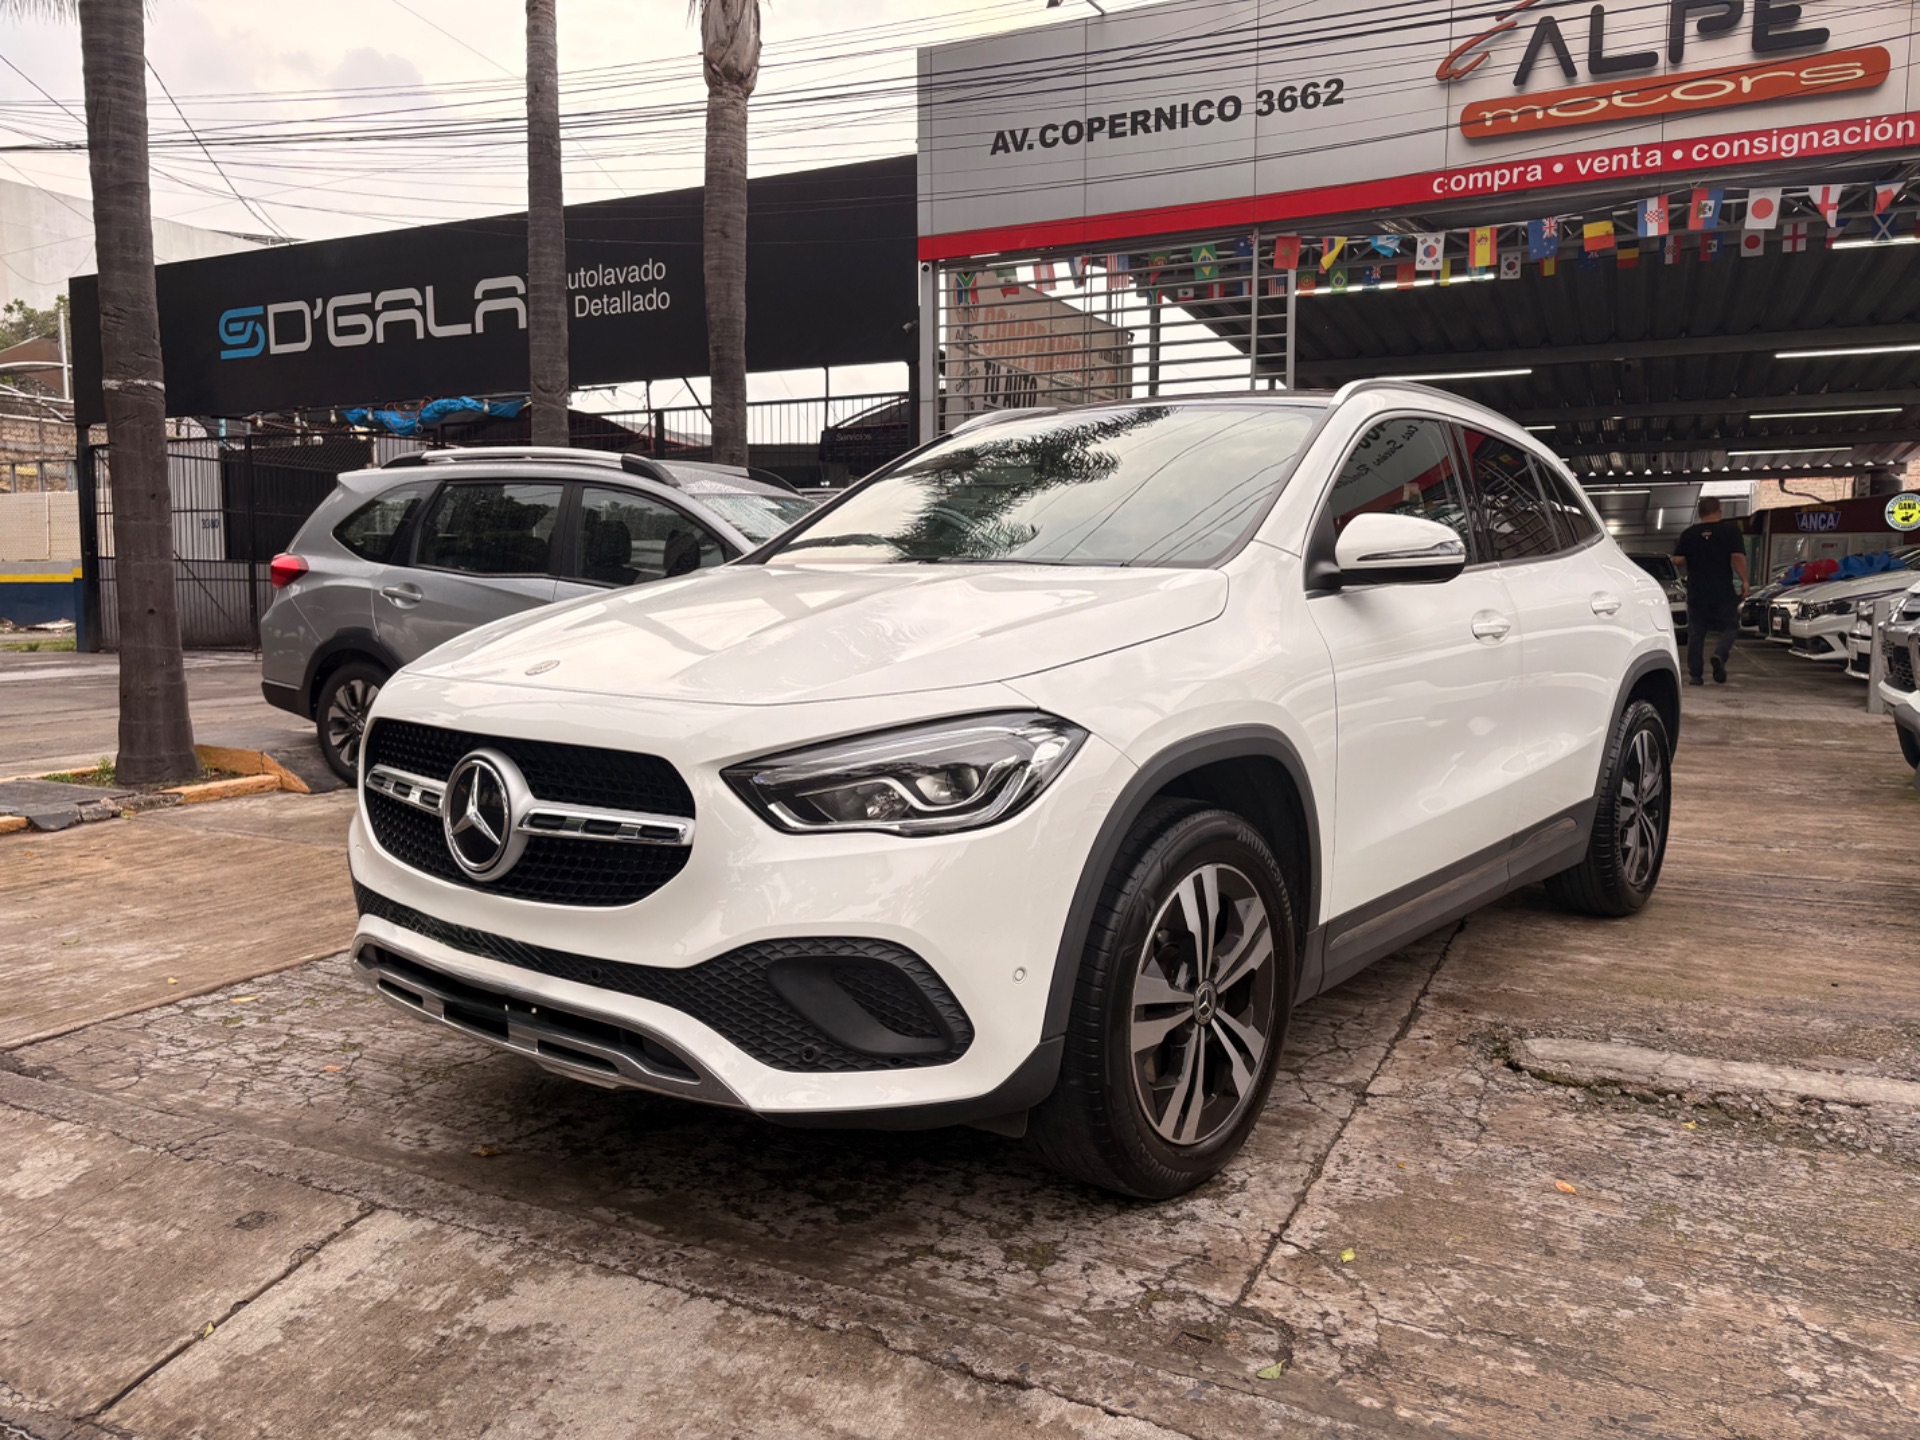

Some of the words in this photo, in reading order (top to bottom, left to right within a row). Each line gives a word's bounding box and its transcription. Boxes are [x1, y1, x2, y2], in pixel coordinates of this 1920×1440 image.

[1255, 78, 1345, 117] 3662
[1478, 60, 1866, 126] motors
[1432, 161, 1543, 193] compra
[1576, 145, 1662, 176] venta
[1691, 116, 1916, 163] consignación
[564, 257, 667, 290] utolavado
[574, 287, 671, 318] Detallado
[983, 359, 1000, 402] TU
[1003, 369, 1038, 408] AUTO
